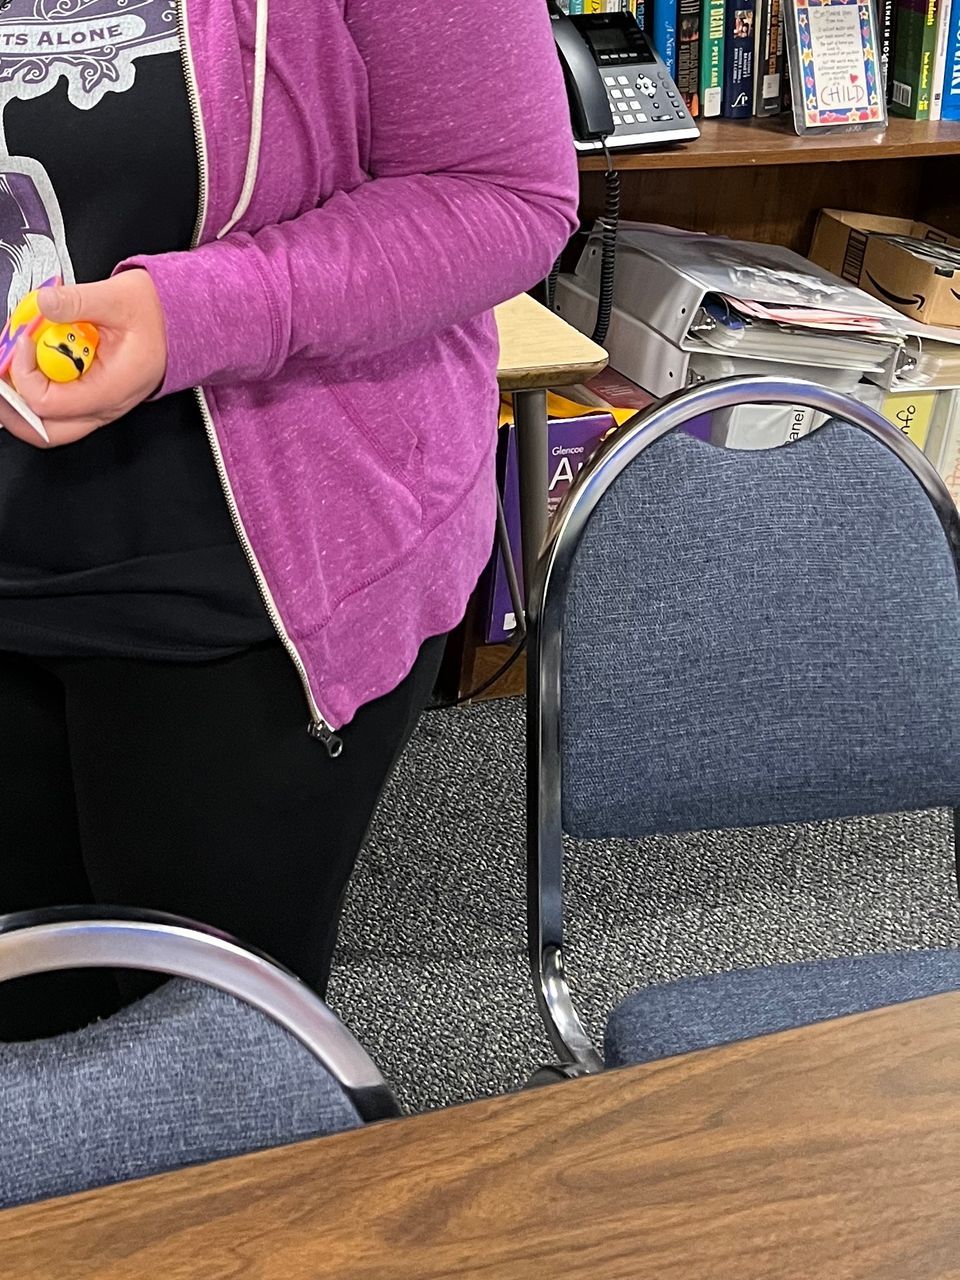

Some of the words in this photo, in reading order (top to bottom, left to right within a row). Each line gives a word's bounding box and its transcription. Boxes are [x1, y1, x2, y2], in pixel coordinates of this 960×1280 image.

[709, 8, 724, 39] DEATH
[884, 28, 890, 37] IN
[37, 24, 122, 48] ALONE
[666, 34, 675, 56] New
[711, 46, 719, 65] PETE
[821, 85, 865, 107] CHILD
[789, 409, 804, 446] anel
[552, 445, 584, 456] Glencoe
